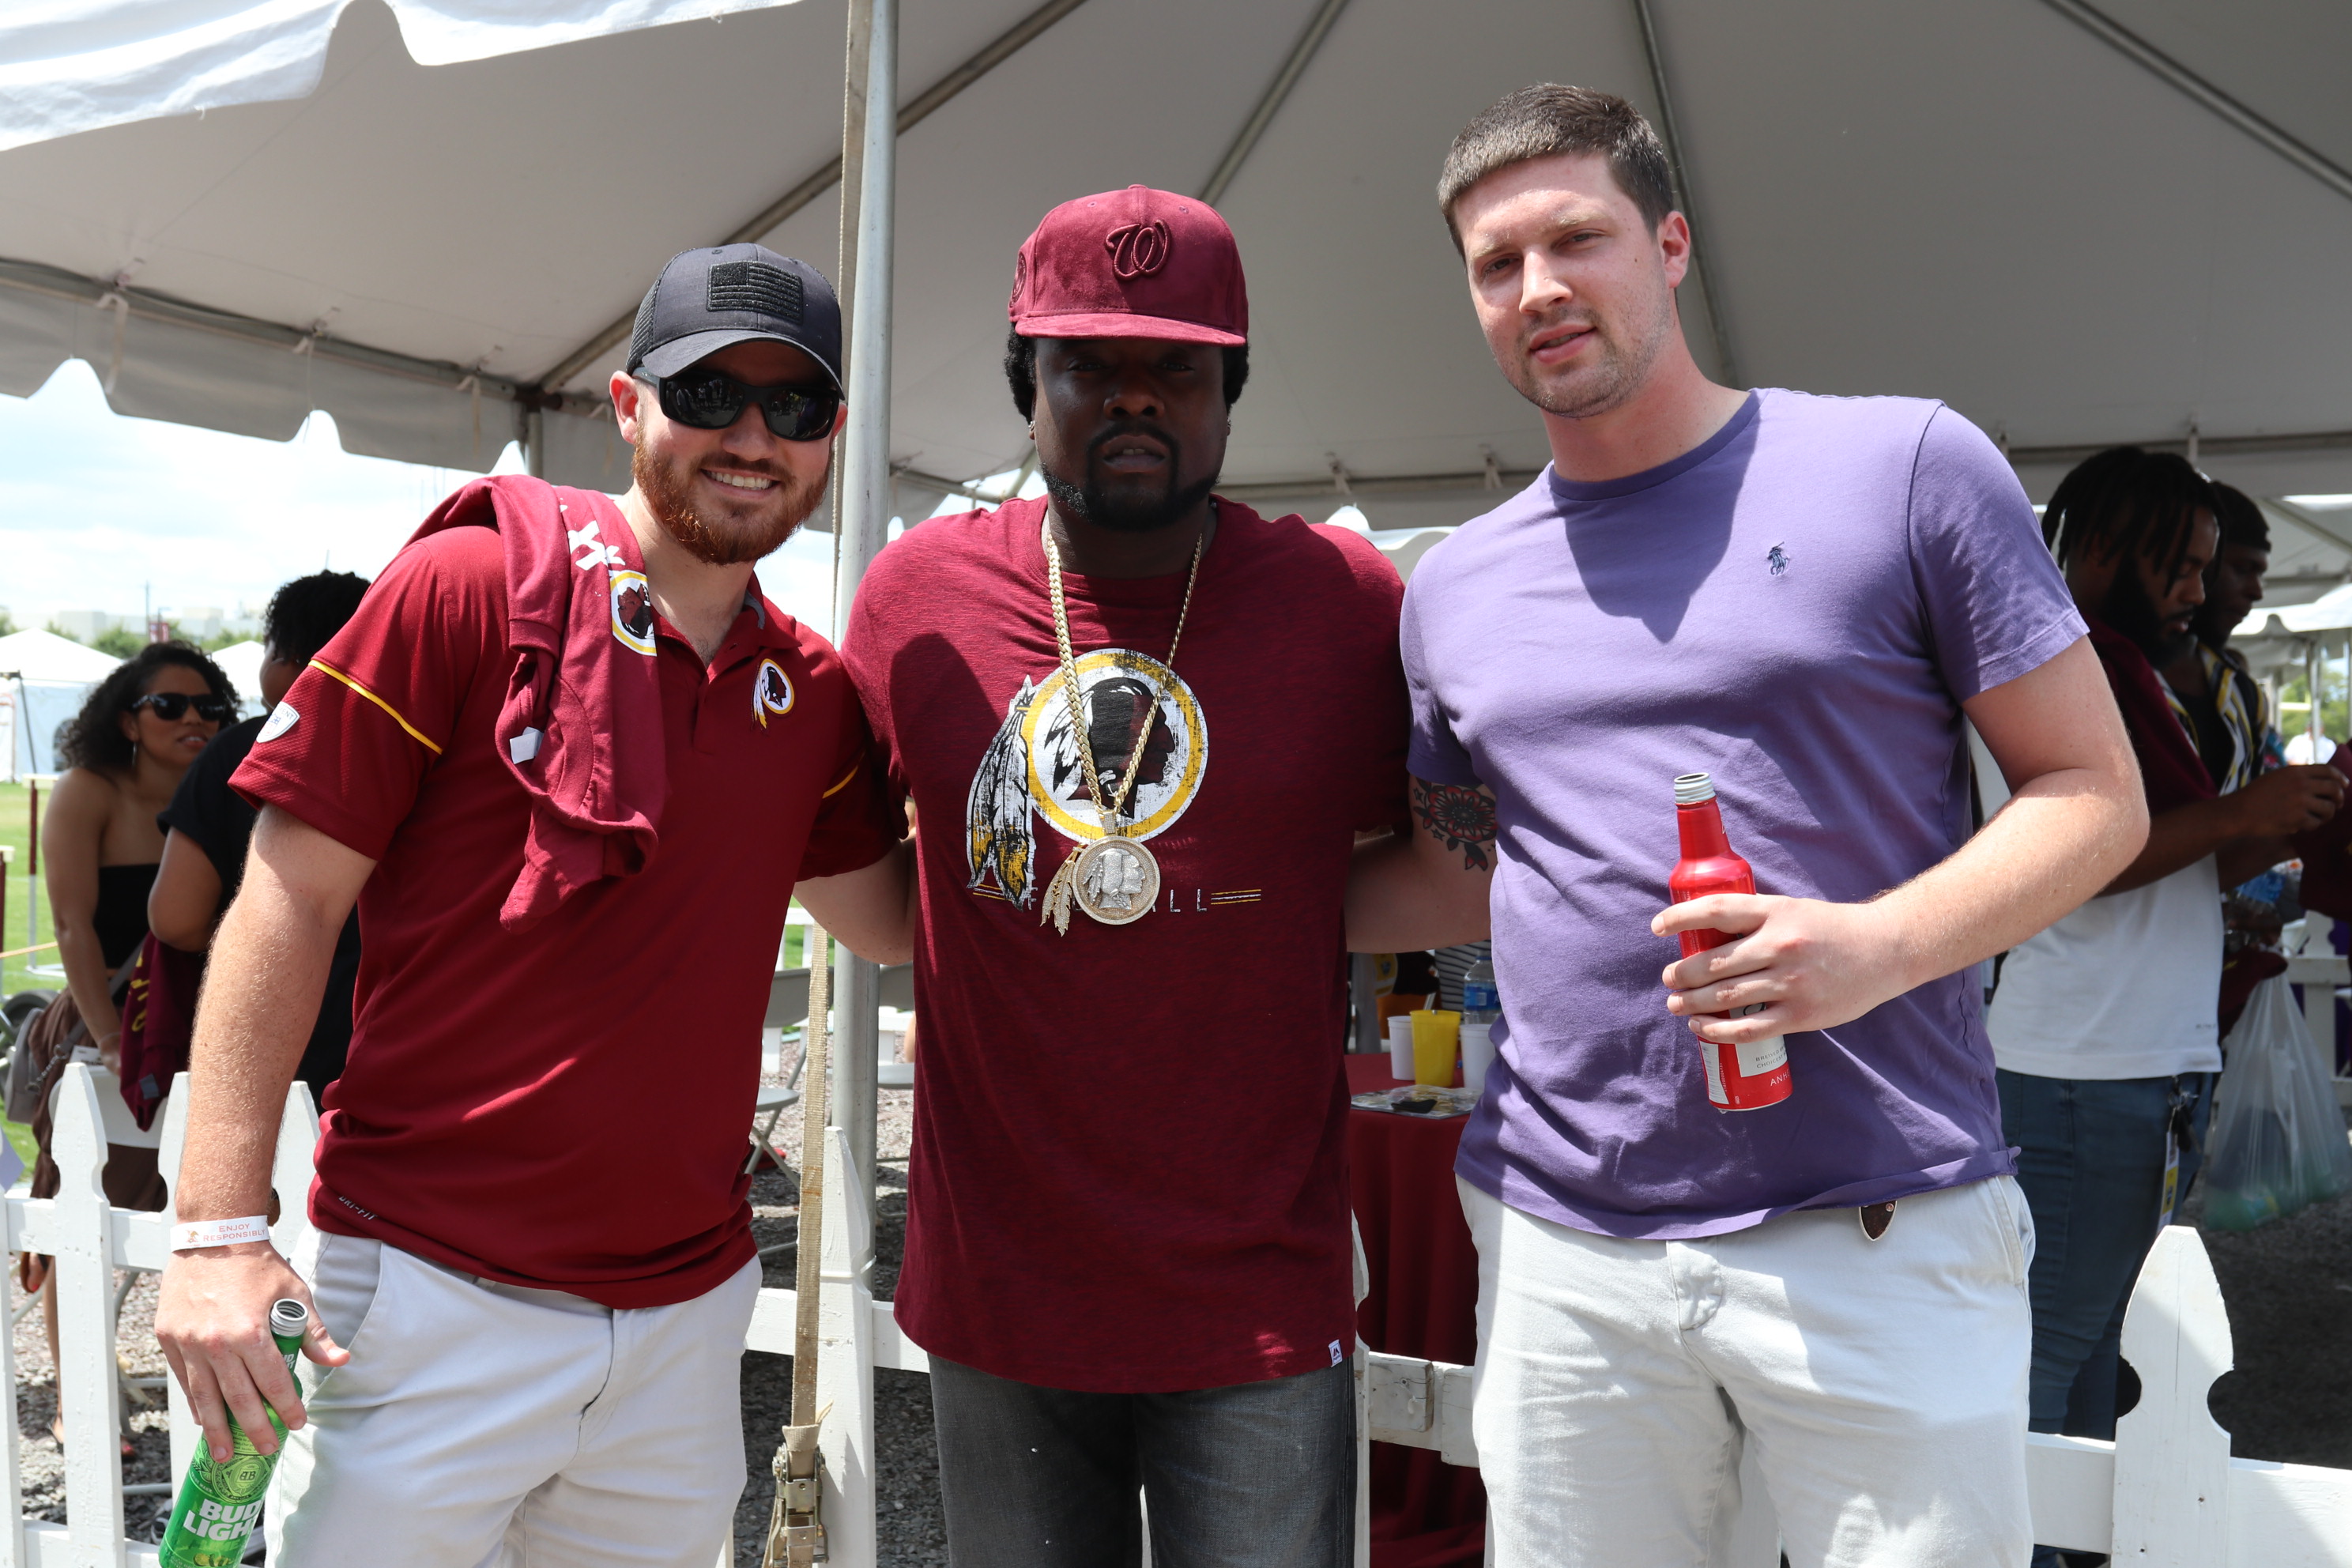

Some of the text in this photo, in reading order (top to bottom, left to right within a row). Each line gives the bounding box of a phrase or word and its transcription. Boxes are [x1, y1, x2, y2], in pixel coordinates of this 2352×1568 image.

[1106, 219, 1170, 278] W
[338, 1195, 378, 1220] DRI-FIT
[203, 1229, 266, 1242] RESPONSIBLY
[218, 1223, 251, 1233] ENJOY
[199, 1498, 262, 1523] BUD
